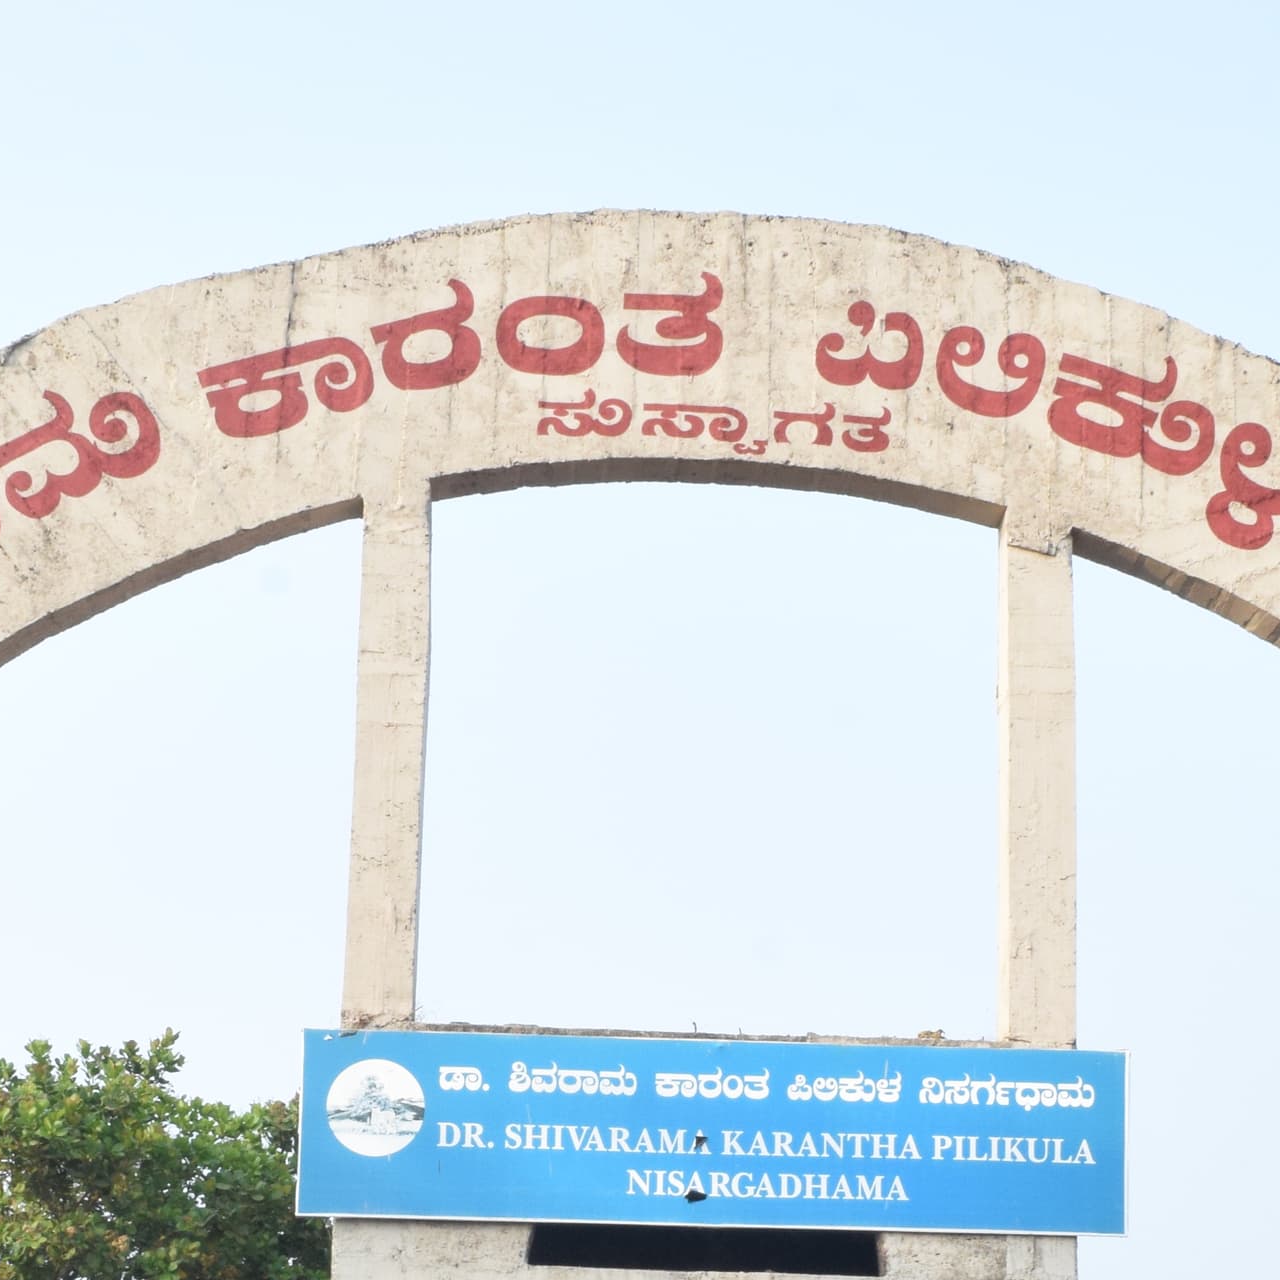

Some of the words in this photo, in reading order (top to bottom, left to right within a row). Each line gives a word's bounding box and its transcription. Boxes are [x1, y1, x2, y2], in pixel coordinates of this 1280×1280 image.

[197, 271, 724, 438] ಕಾರಂತ
[536, 389, 892, 455] ಸುಸ್ವಾಗತ
[438, 1065, 491, 1092] ಡಾ.
[508, 1060, 638, 1097] ಶಿವರಾಮ
[655, 1065, 771, 1100] ಕಾರಂತ
[786, 1070, 903, 1104] ಪಿಲಿಕುಳ
[919, 1073, 1096, 1112] ನಿಸರ್ಗಧಾಮ
[436, 1121, 495, 1149] DR.
[504, 1123, 712, 1155] SHIVARAMA
[721, 1130, 923, 1160] KARANTHA
[931, 1135, 1097, 1165] PILIKULA
[626, 1169, 910, 1201] NISARGADHAMA
